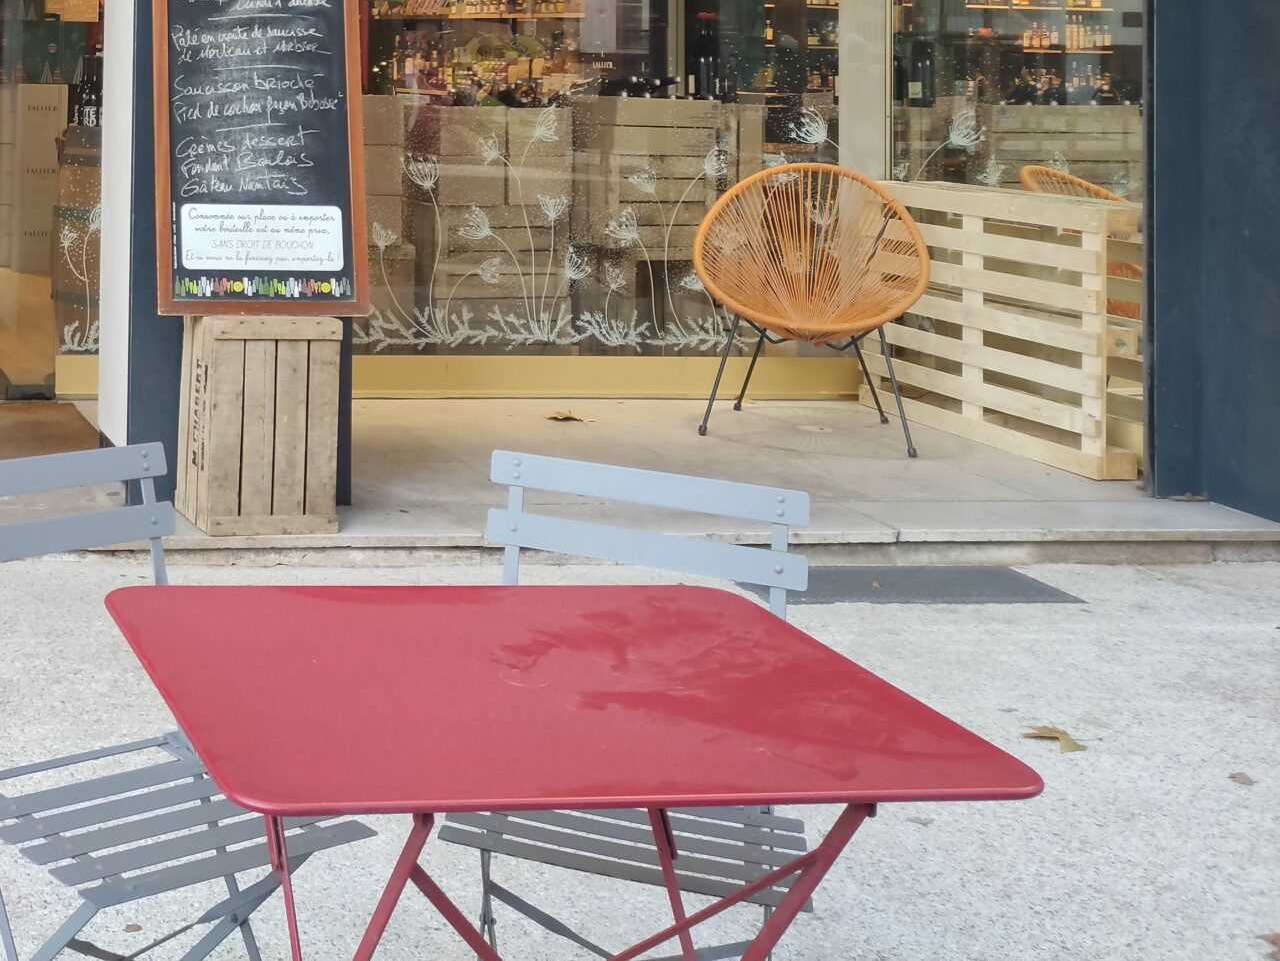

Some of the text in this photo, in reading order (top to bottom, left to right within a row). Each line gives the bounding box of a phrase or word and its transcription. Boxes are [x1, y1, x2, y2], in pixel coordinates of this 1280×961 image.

[188, 207, 234, 220] Consommée
[254, 208, 276, 224] place
[298, 212, 336, 226] emporter
[194, 223, 217, 233] votre
[219, 221, 254, 234] bouteille
[256, 225, 269, 234] est
[211, 240, 314, 250] SANS DROIT DE BOUCHON
